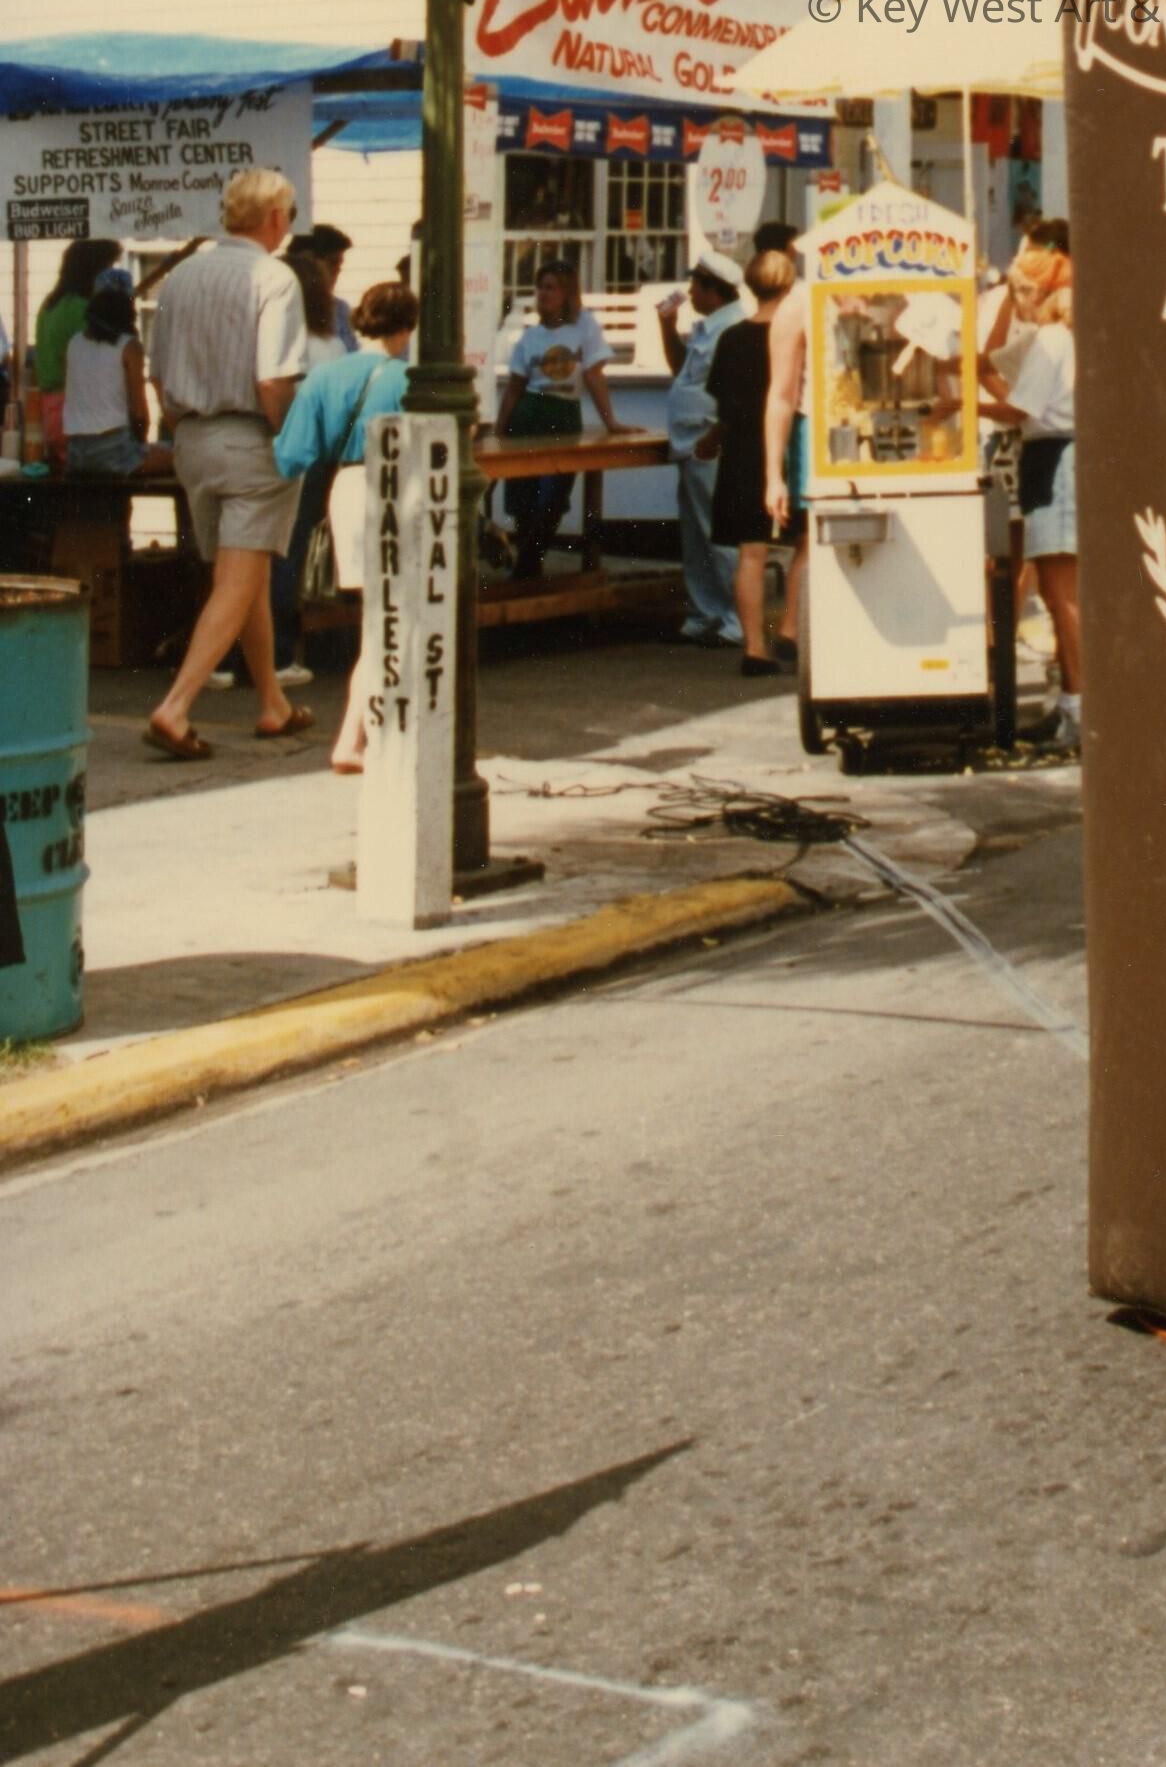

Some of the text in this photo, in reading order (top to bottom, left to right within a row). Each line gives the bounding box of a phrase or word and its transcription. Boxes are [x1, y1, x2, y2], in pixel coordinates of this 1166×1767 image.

[552, 30, 662, 82] NATURAL
[79, 118, 212, 143] STREET FAIR
[42, 142, 254, 170] REFRESHMENT CENTER
[14, 172, 122, 195] SUPPORTS
[129, 175, 180, 192] Monroe
[182, 170, 224, 195] County
[10, 202, 88, 219] Budweiser
[44, 222, 85, 239] LIGHT
[817, 228, 969, 280] POPCORN
[426, 441, 450, 604] DUVAL
[368, 425, 411, 733] CHARLES ST
